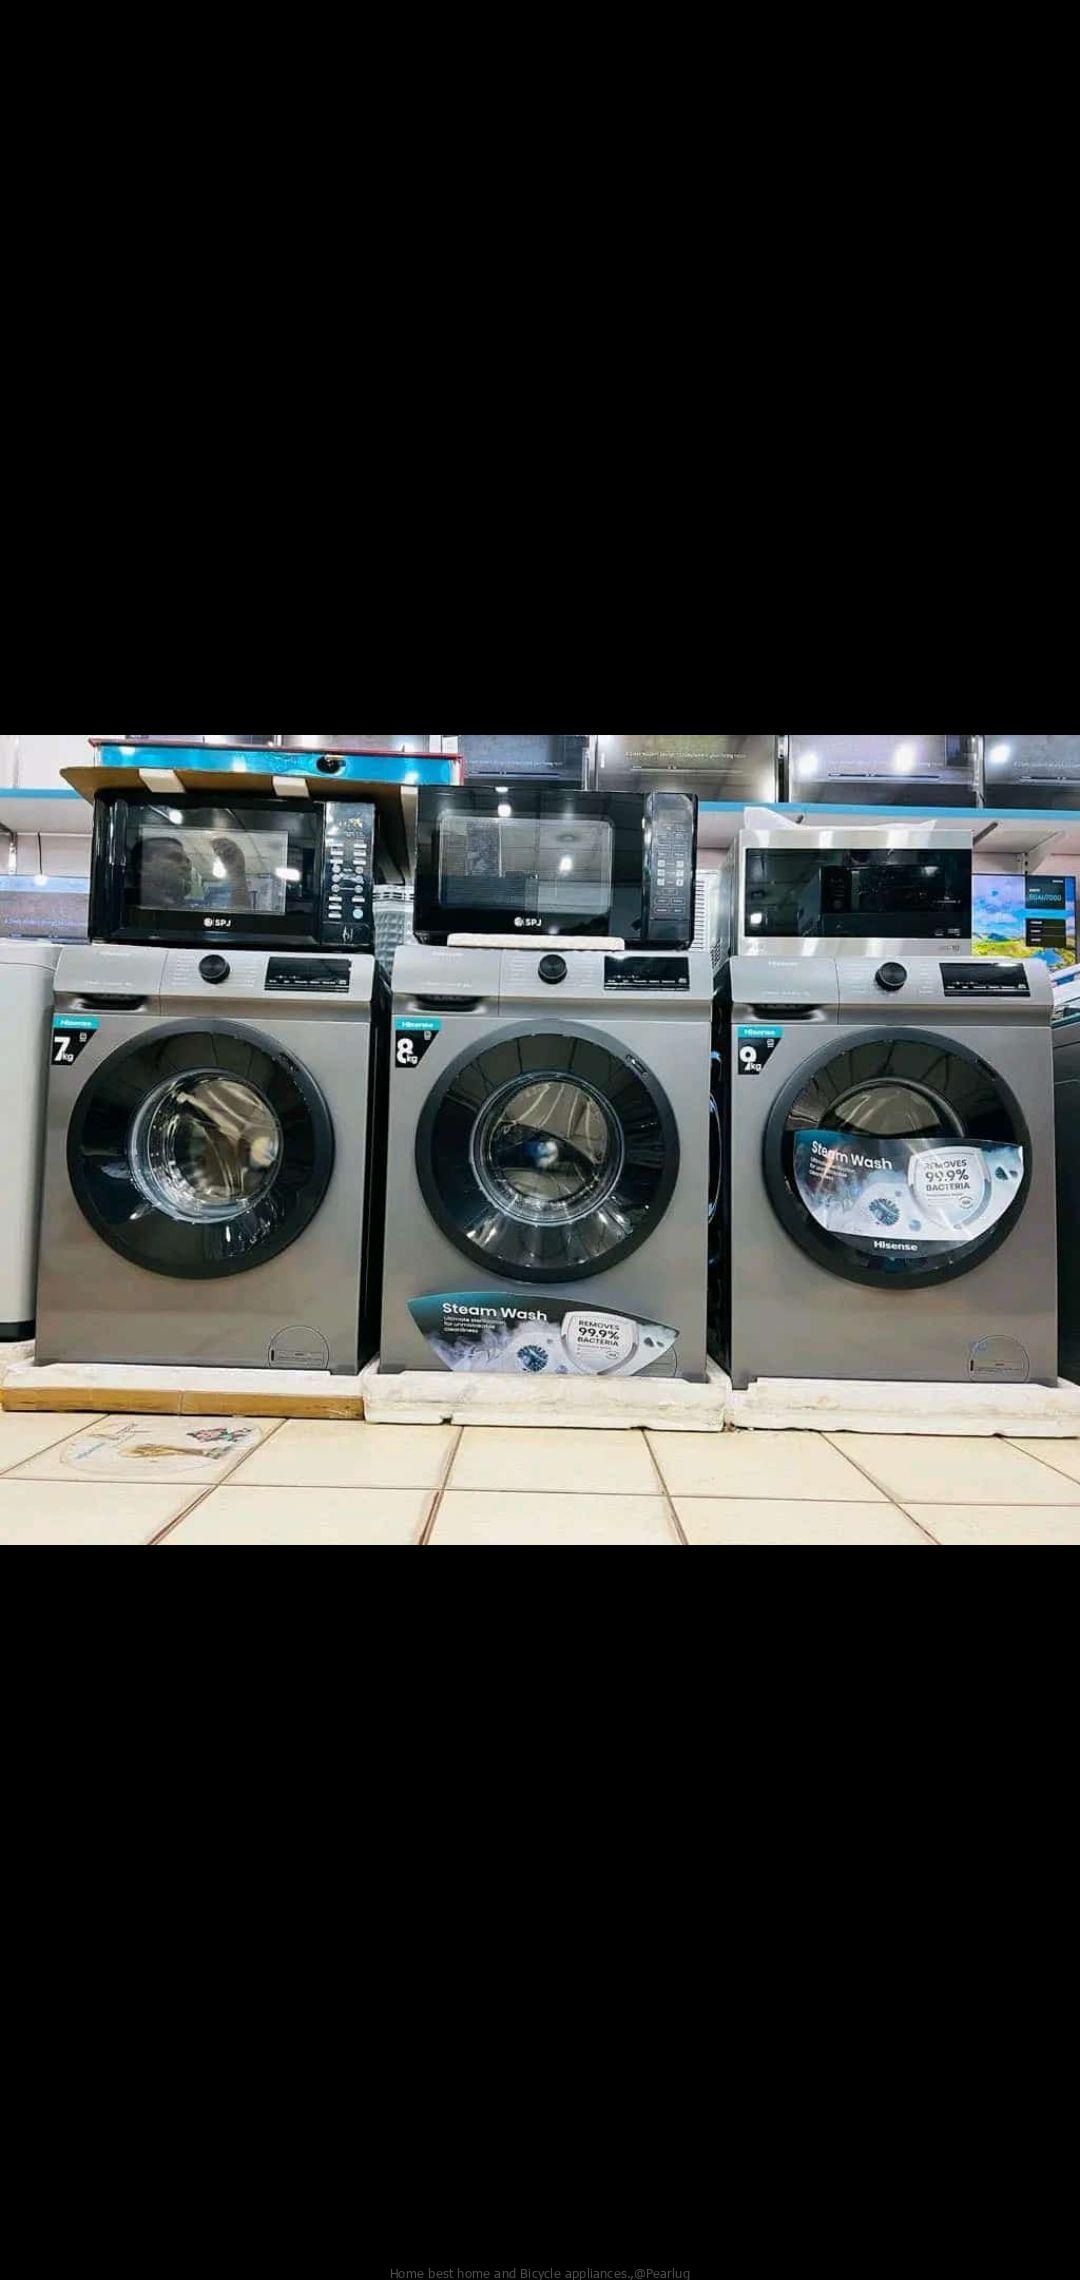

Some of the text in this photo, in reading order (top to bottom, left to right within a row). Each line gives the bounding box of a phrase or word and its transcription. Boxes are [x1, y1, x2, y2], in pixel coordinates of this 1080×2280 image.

[215, 918, 231, 927] SPJ
[525, 918, 542, 927] SPJ
[811, 1140, 849, 1165] Steam
[850, 1153, 893, 1171] Wash
[925, 1168, 969, 1182] 99.9%
[926, 1182, 971, 1191] BACTERIA
[873, 1240, 919, 1251] Hisense
[442, 1301, 548, 1321] Steam Wash
[578, 1320, 620, 1331] REMOVES
[578, 1326, 620, 1341] 99.9%
[577, 1336, 620, 1347] BACTERIA
